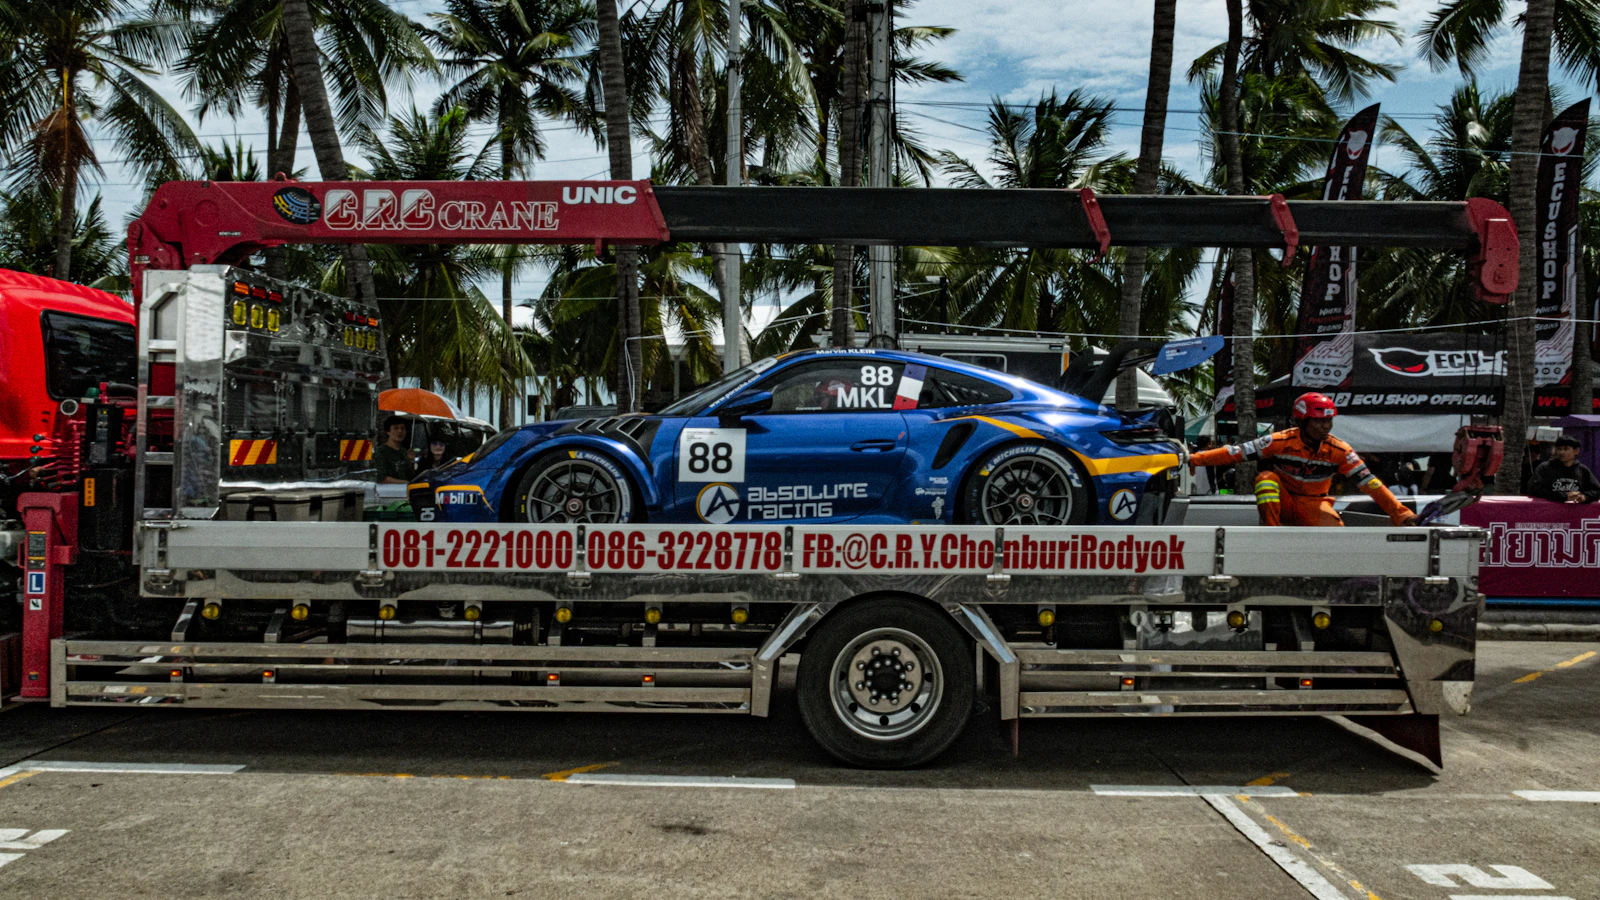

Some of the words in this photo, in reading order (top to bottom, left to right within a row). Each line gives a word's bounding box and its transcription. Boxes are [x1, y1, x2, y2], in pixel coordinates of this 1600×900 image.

[562, 186, 637, 205] UNIC
[438, 200, 559, 231] CRANE
[861, 366, 893, 385] 88
[837, 387, 892, 408] MKL
[1351, 394, 1384, 406] ECU
[1384, 394, 1428, 406] SHOP
[1430, 394, 1496, 406] OFFICIAL
[584, 453, 621, 478] MICHELIN
[689, 442, 732, 473] 88
[992, 447, 1036, 465] MICHELIN
[435, 492, 464, 505] Mobil
[383, 529, 573, 568] 081-2221000
[588, 531, 782, 570] 086-3228778
